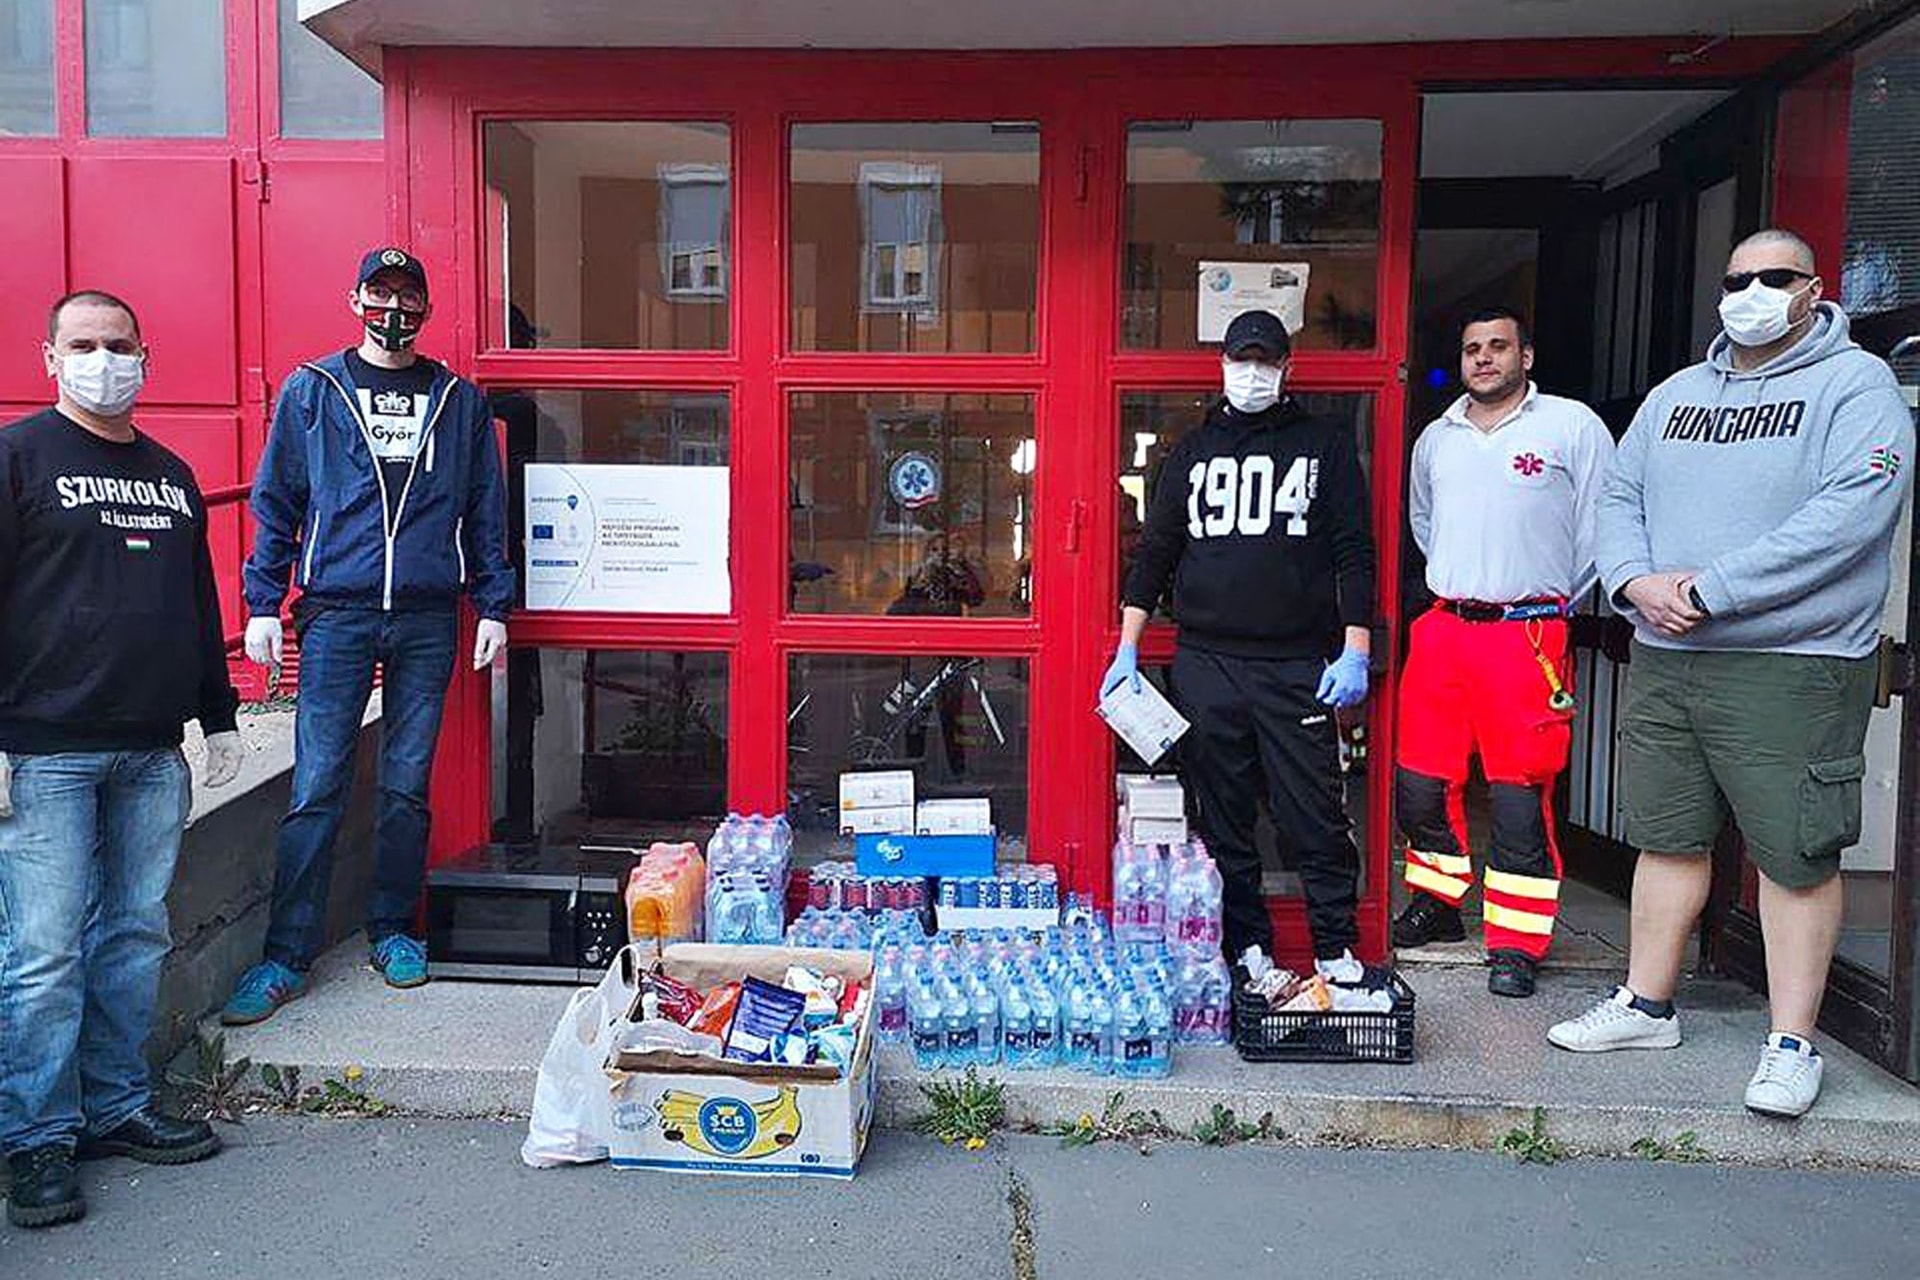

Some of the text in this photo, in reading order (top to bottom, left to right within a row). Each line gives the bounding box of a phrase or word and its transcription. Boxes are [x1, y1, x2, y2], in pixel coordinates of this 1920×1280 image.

[371, 424, 416, 445] Győr
[1661, 400, 1806, 444] HUNGARIA
[56, 475, 193, 517] SZURKOLÓK
[1187, 455, 1311, 539] 1904
[709, 1114, 746, 1128] SCB
